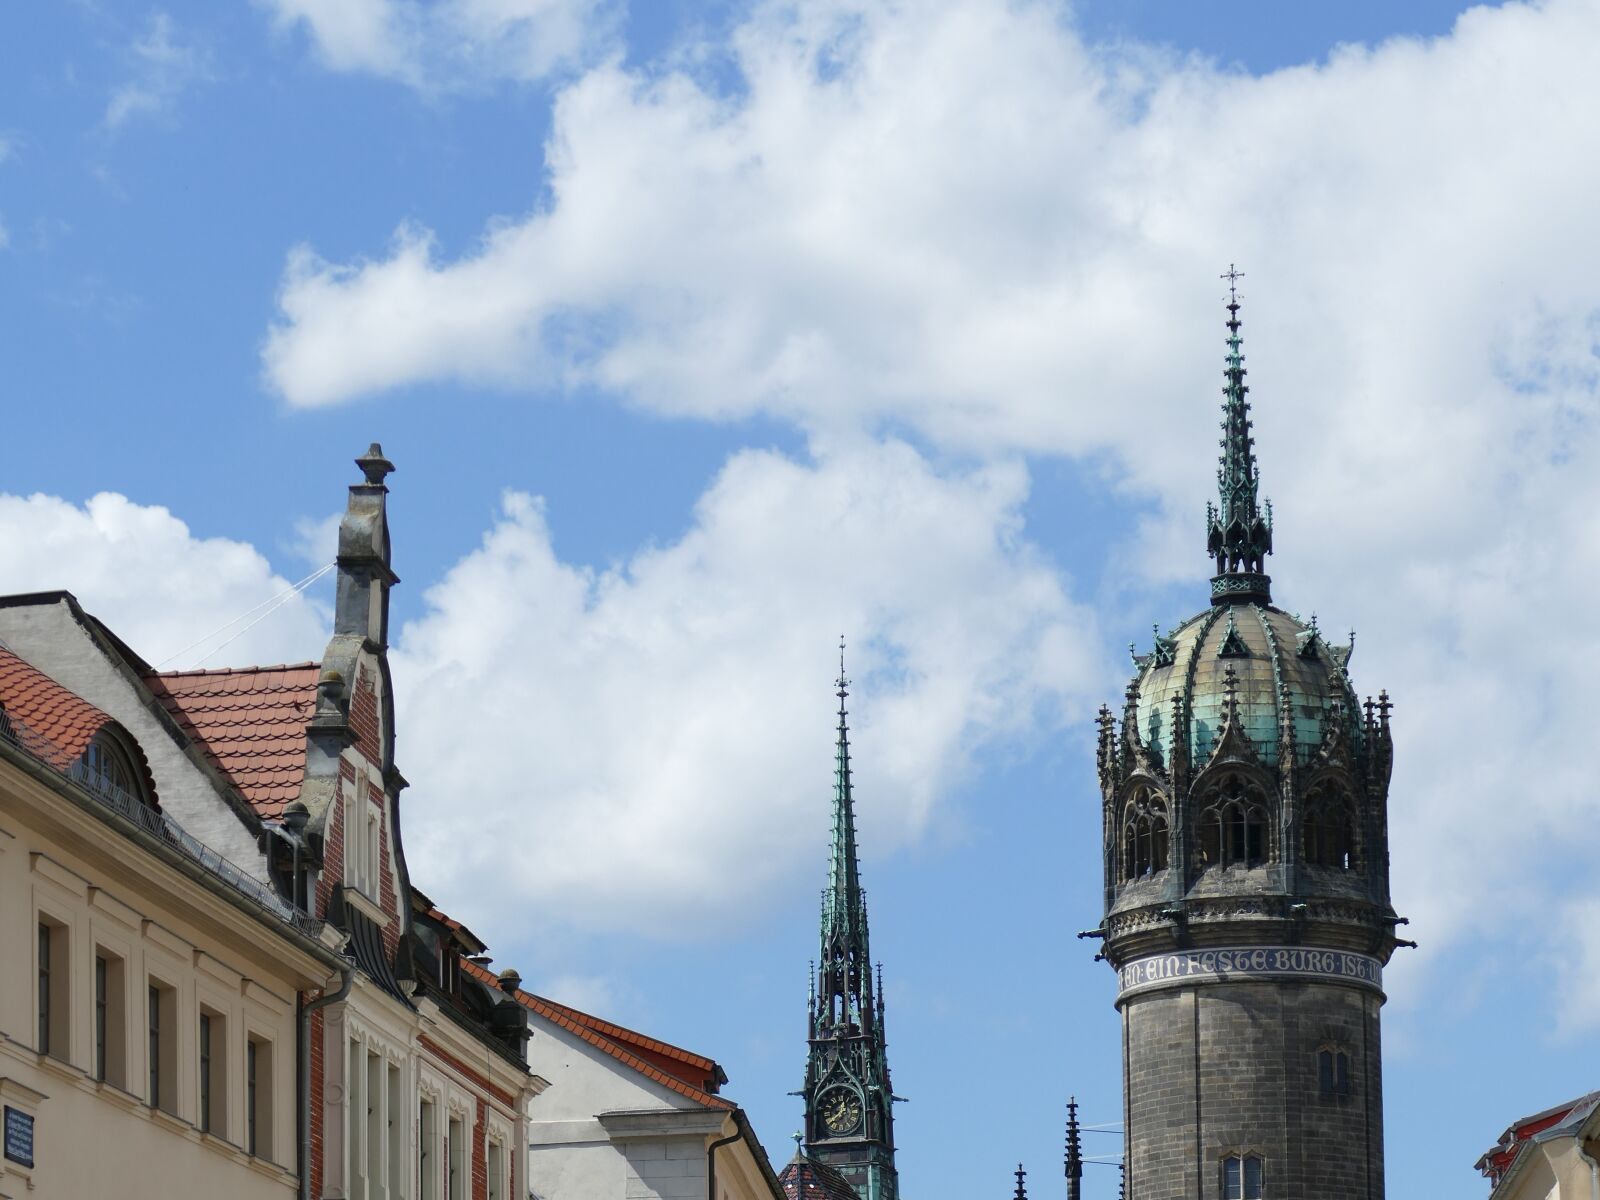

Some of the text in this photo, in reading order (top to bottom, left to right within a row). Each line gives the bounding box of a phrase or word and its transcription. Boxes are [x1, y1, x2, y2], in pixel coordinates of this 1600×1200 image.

[1146, 955, 1180, 981] EIN
[1186, 950, 1269, 975] FESTE
[1274, 950, 1335, 973] BURG
[1340, 954, 1366, 978] IST
